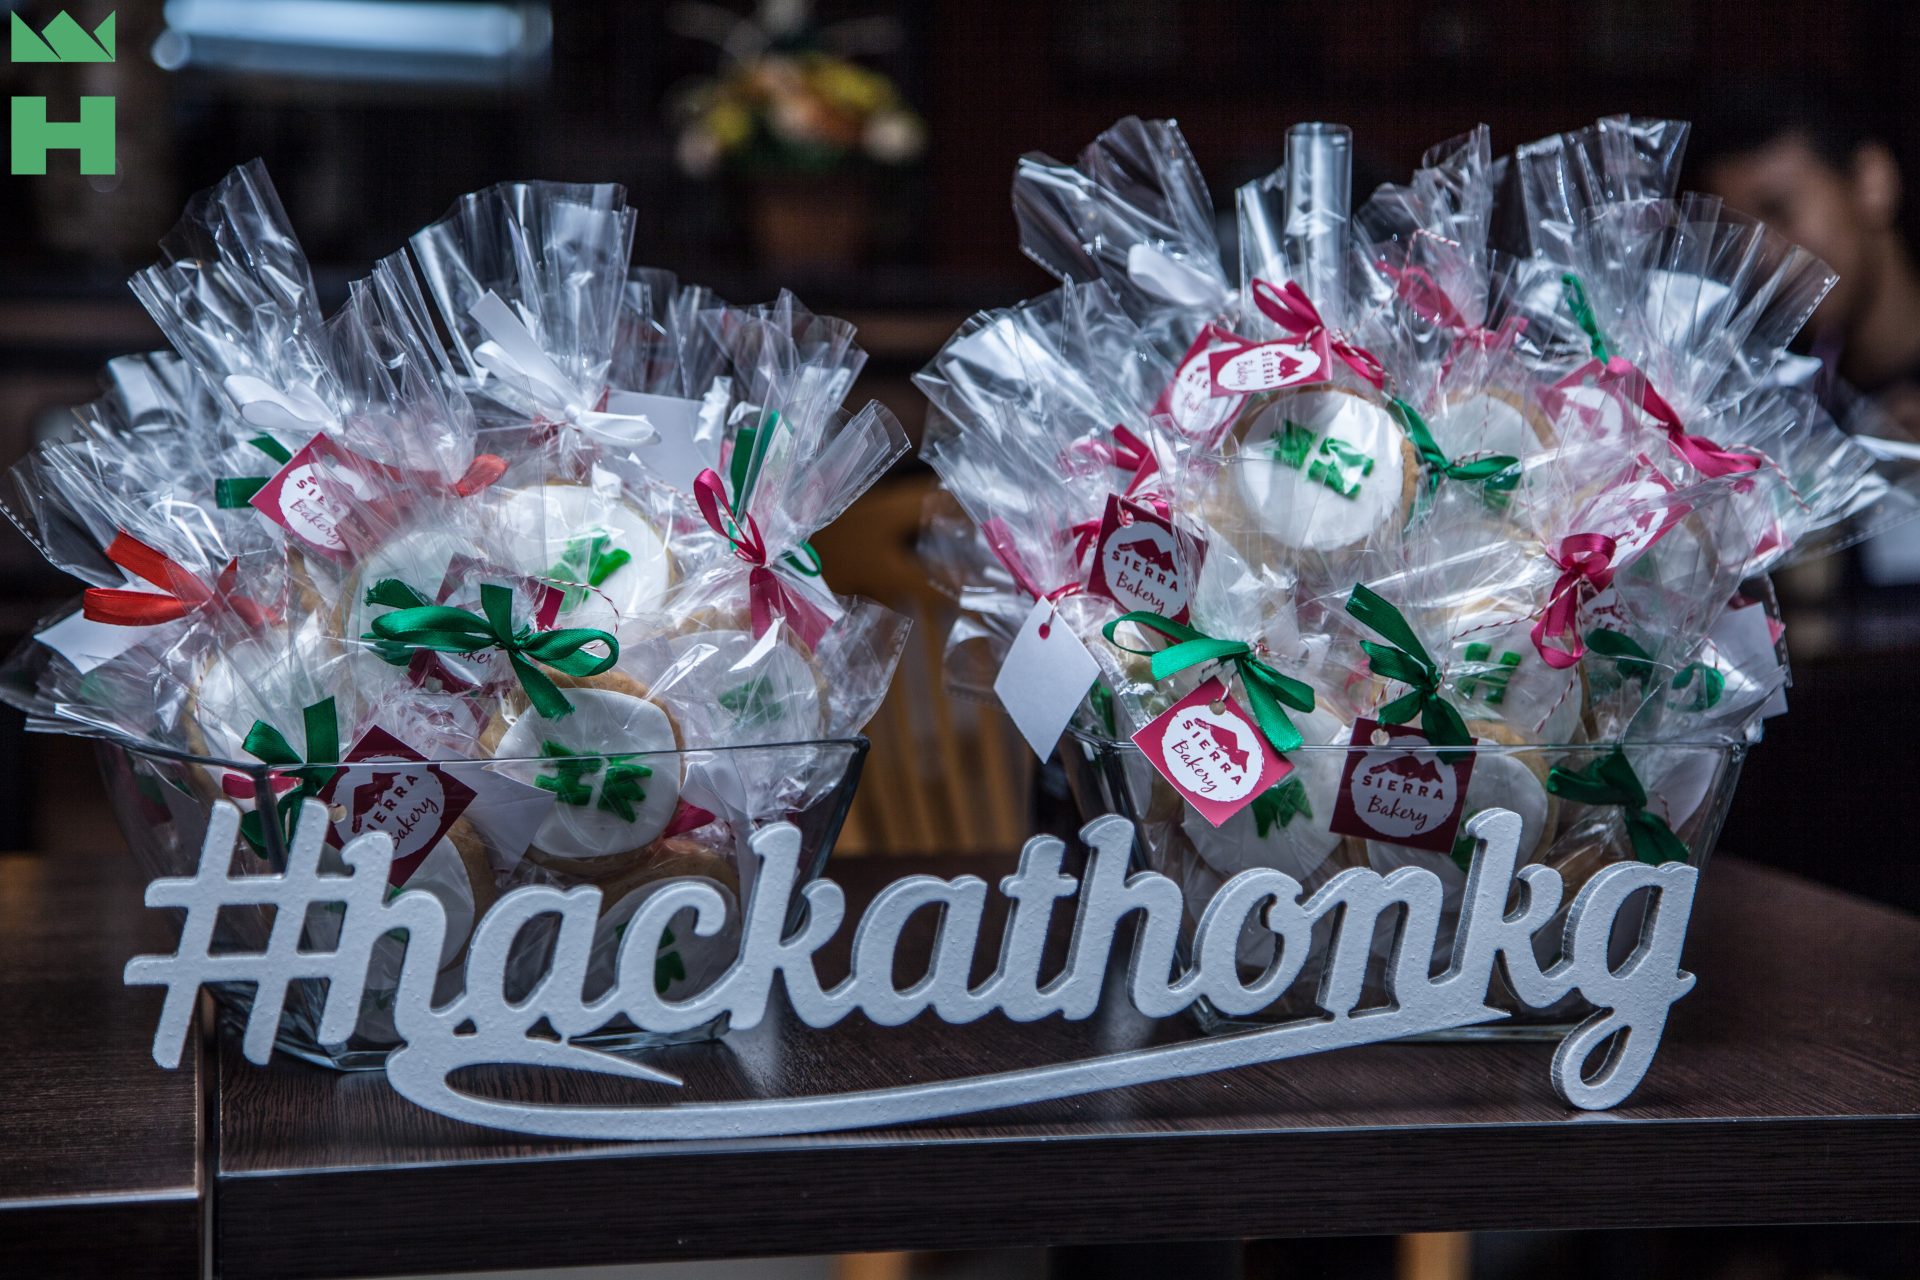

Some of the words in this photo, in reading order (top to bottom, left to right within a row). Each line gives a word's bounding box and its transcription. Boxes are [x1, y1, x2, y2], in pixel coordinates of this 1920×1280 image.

[1112, 550, 1178, 592] SIERRA
[1116, 571, 1165, 614] Bakery
[1171, 739, 1217, 793] Bakery
[1182, 720, 1242, 785] SIERRA
[367, 774, 419, 830] IERRA
[1362, 775, 1444, 800] SIERRA
[1367, 794, 1428, 830] Bakery
[124, 798, 1698, 1112] #hackathonkg
